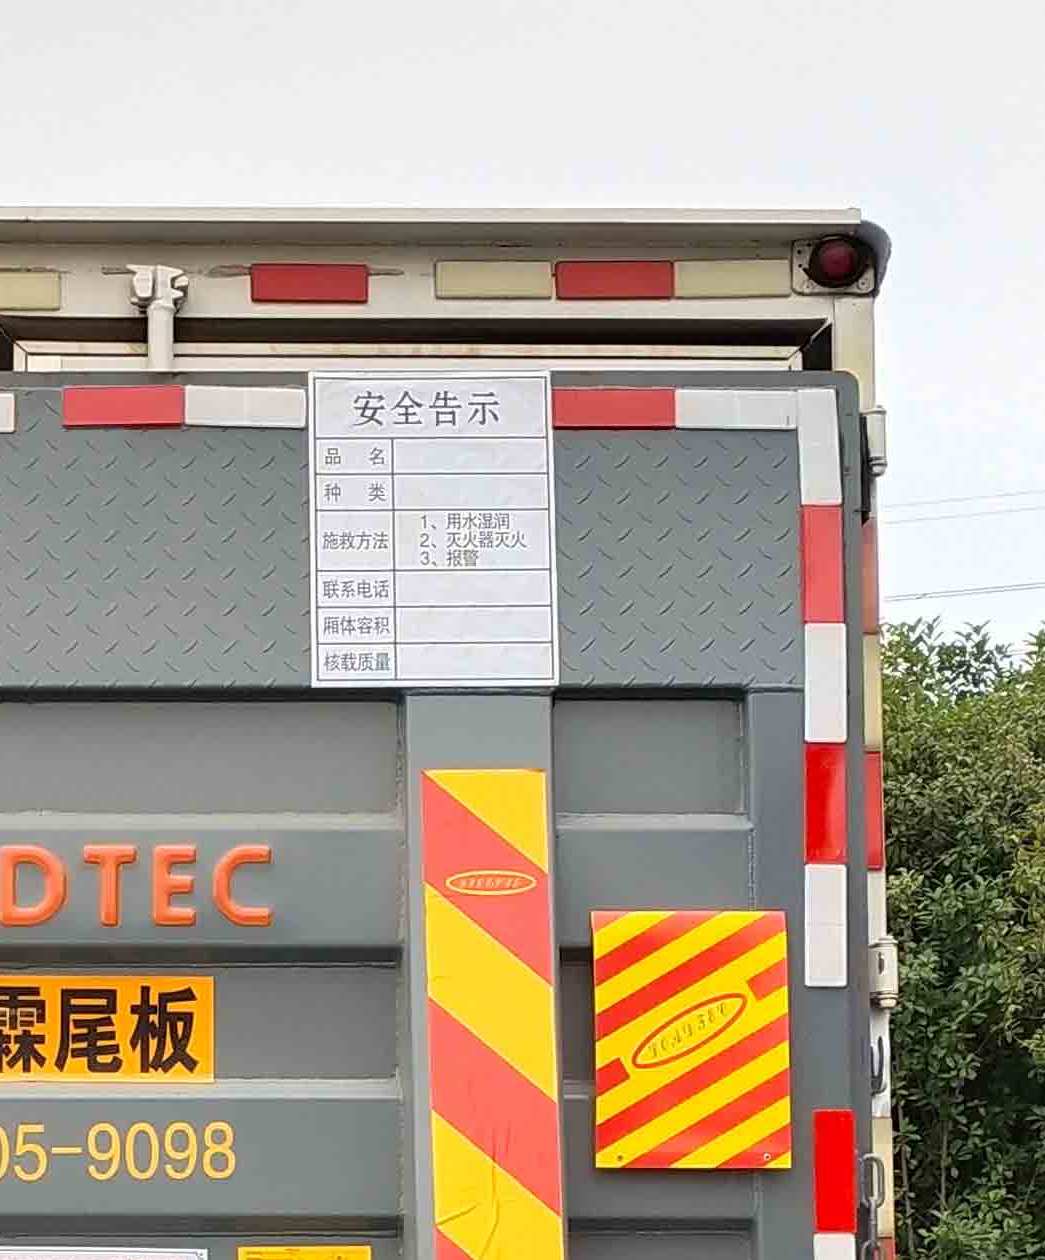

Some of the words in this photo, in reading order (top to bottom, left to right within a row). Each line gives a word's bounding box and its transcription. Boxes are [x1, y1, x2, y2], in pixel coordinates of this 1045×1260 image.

[353, 390, 500, 427] 安全告示
[323, 532, 389, 550] 施救方法
[323, 580, 389, 599] 联系电话
[323, 616, 390, 635] 厢体容积
[323, 653, 391, 672] 核载质量
